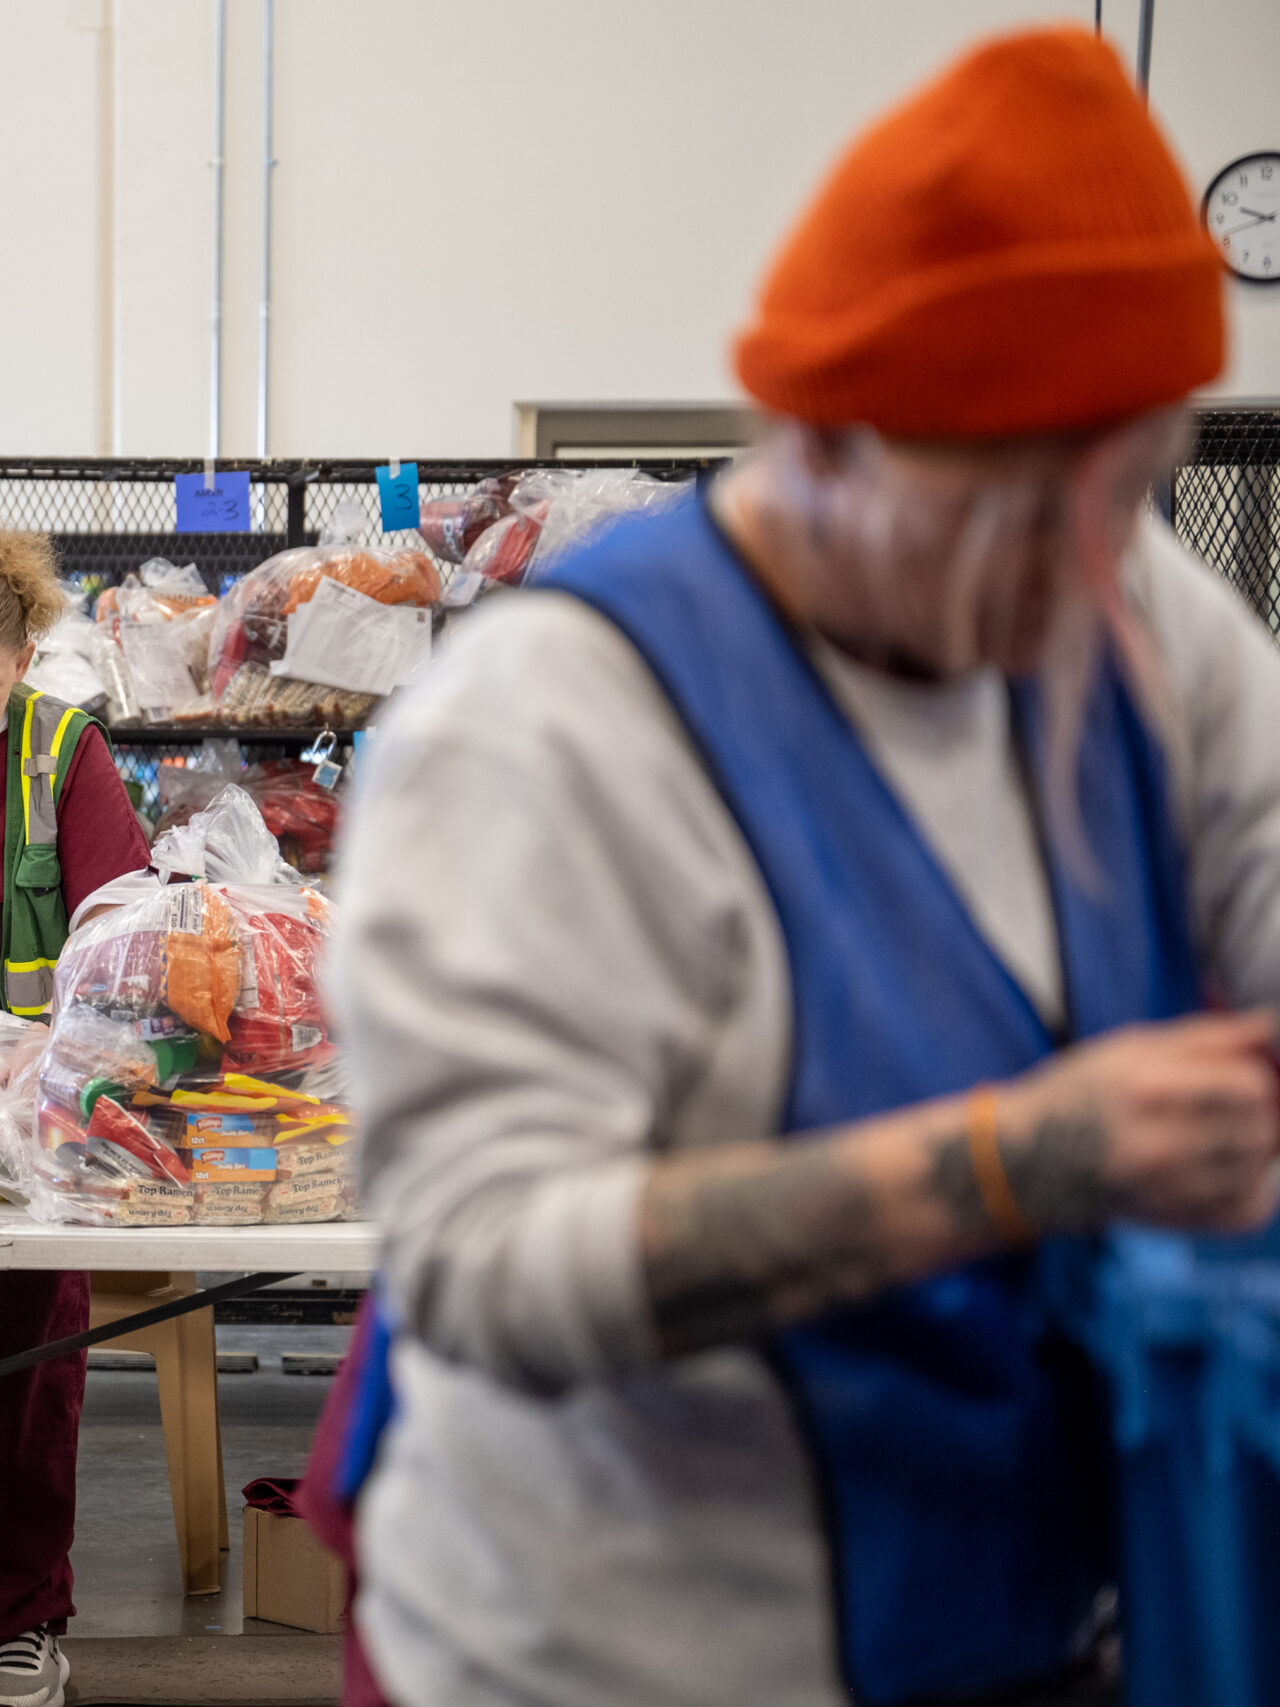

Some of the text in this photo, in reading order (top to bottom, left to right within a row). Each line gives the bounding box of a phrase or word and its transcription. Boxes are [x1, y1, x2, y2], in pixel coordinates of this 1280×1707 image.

[1261, 165, 1273, 181] 12
[1240, 172, 1248, 188] 11
[1222, 191, 1238, 207] 10
[393, 483, 415, 511] 3
[298, 1156, 314, 1166] Top
[138, 1185, 193, 1197] Top Ramen
[216, 1186, 231, 1196] Top
[292, 1183, 310, 1193] Top
[128, 1209, 172, 1218] Top Ramen
[234, 1205, 249, 1213] Top
[305, 1205, 318, 1213] Top
